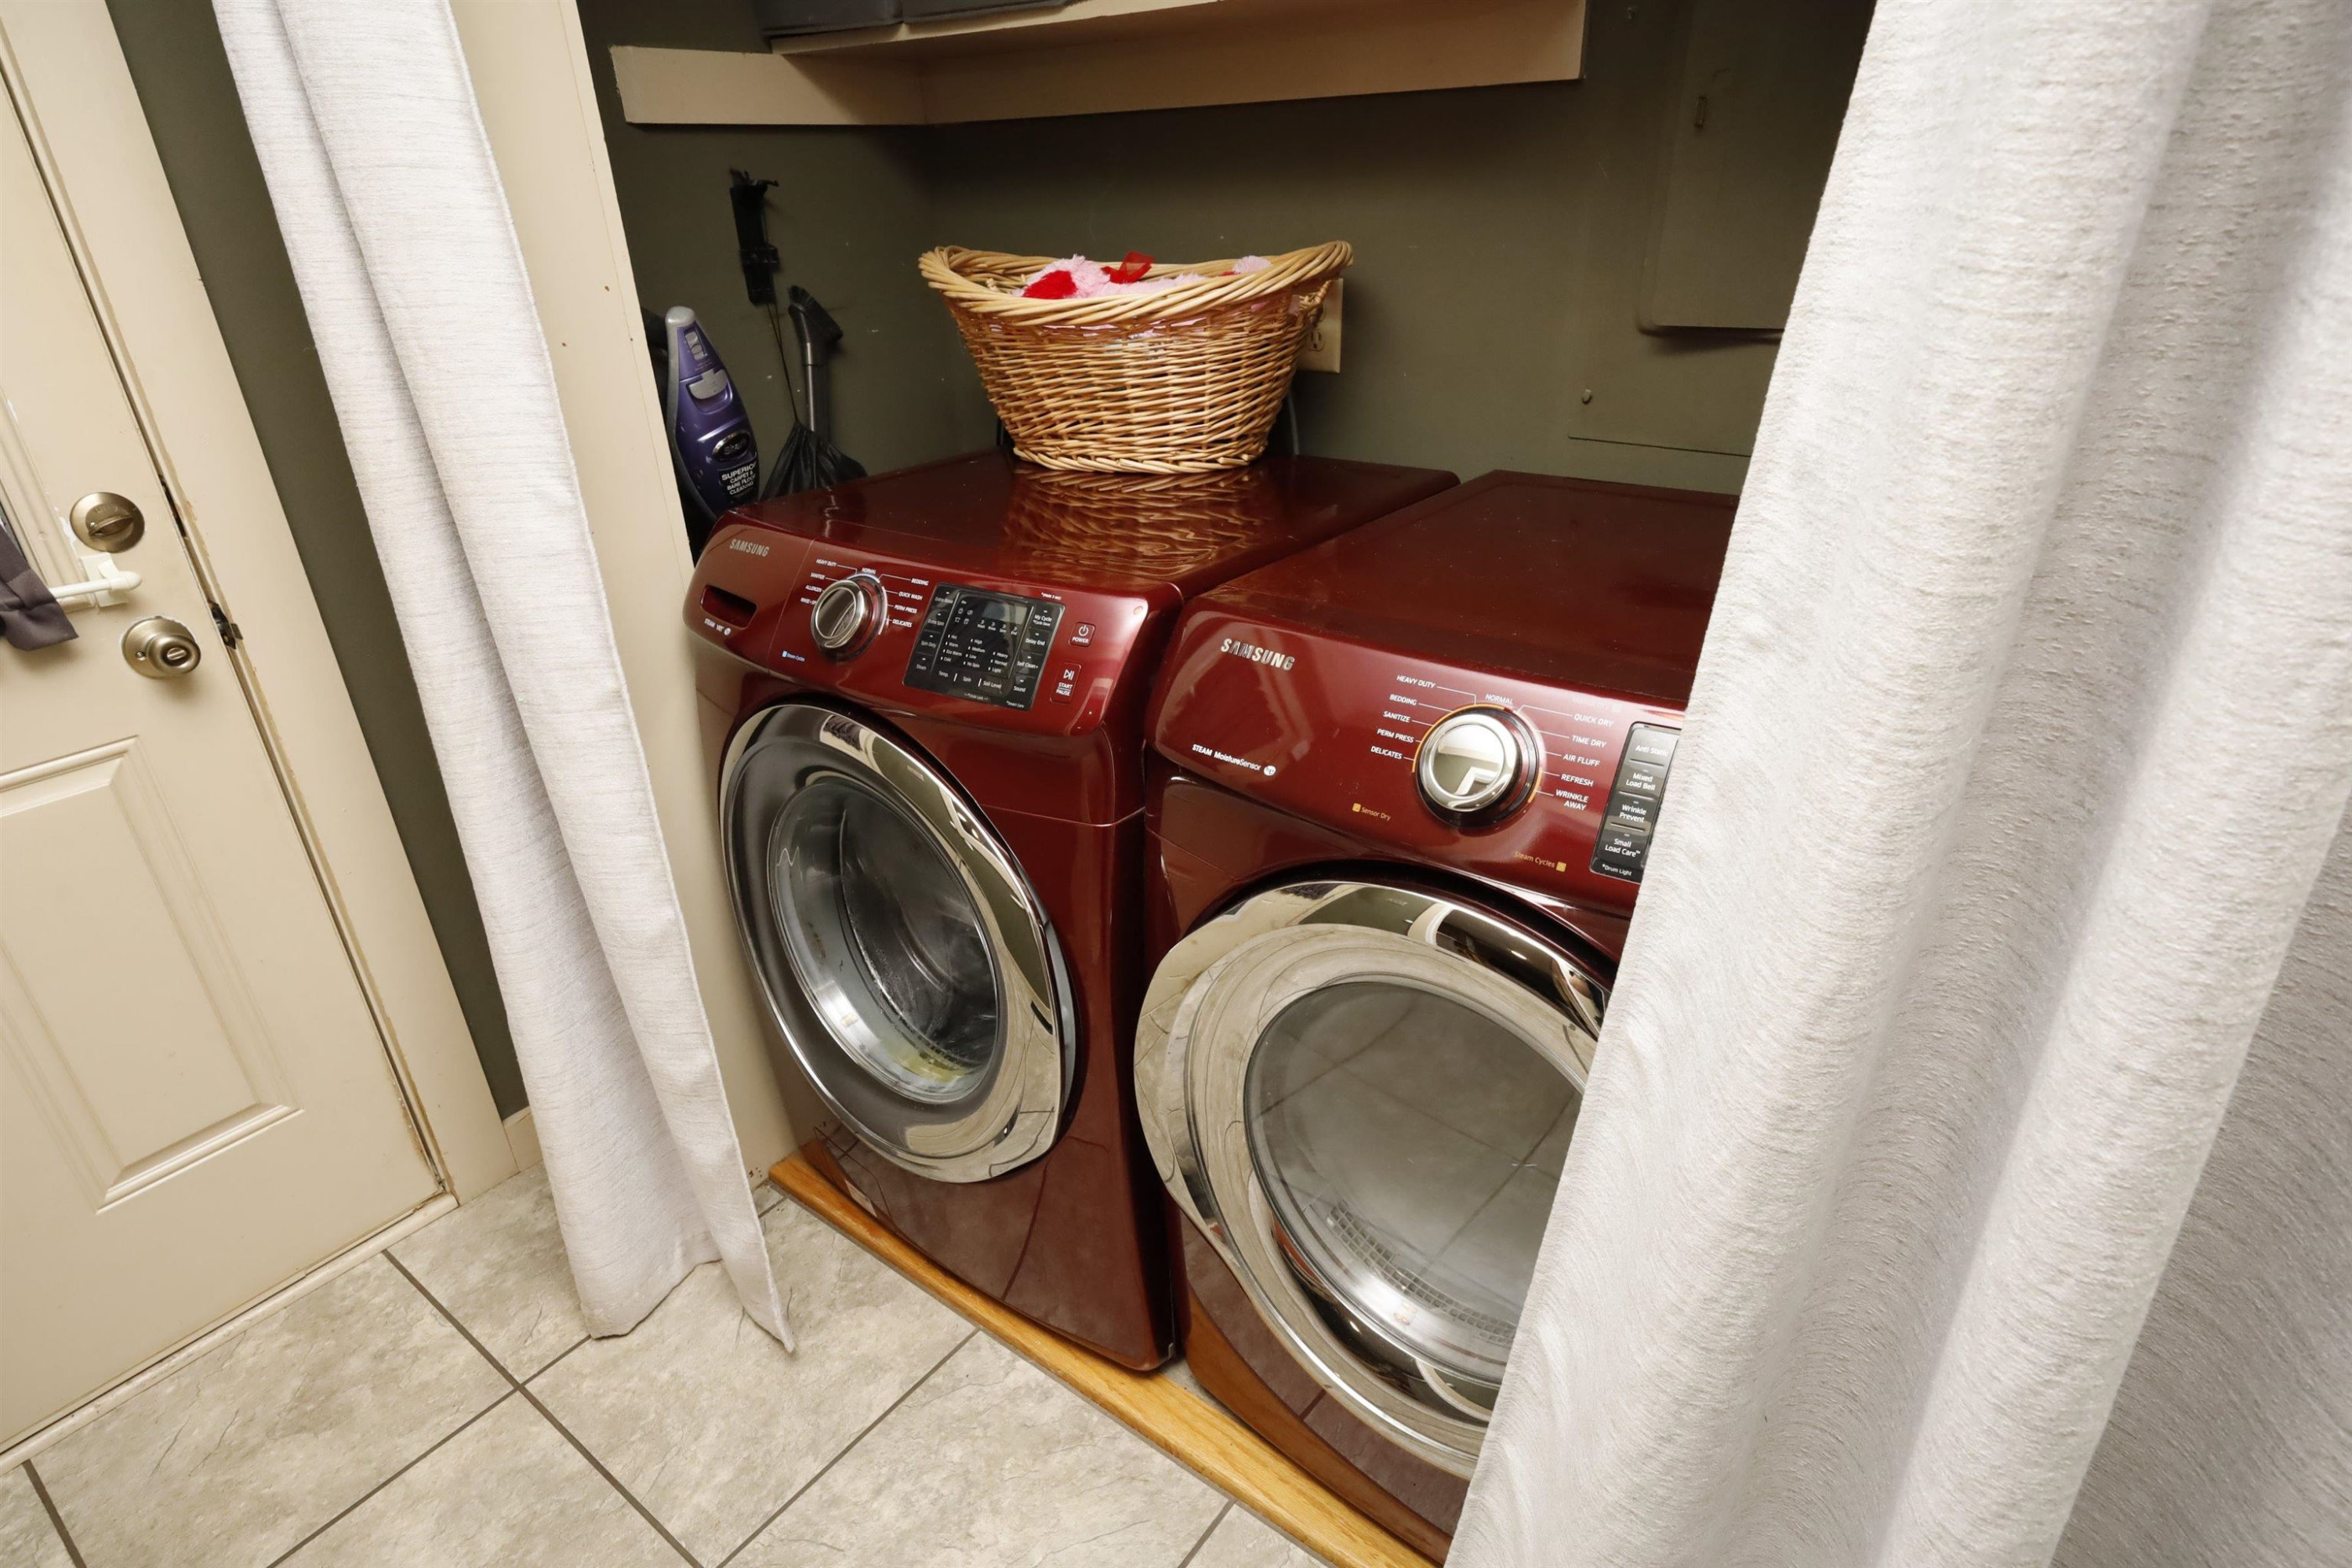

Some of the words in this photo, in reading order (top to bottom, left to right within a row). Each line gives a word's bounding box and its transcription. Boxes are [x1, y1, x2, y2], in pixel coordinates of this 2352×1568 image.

[729, 539, 770, 557] SAMSUNG
[911, 578, 929, 586] BEDDING
[892, 619, 913, 627] DELICATES
[1221, 638, 1295, 671] SAMSUNG
[1396, 674, 1417, 686] HEAVY
[1417, 679, 1436, 688] DUTY
[1389, 694, 1417, 706] BEDDING
[1485, 694, 1513, 706] NORMAL
[1383, 710, 1410, 723] SANITIZE
[1574, 713, 1597, 724] QUICK
[1598, 718, 1614, 728] DRY
[1377, 728, 1396, 739] PERM
[1395, 732, 1414, 743] PRESS
[1572, 735, 1590, 745] TIME
[1590, 739, 1607, 749] DRY
[1192, 744, 1214, 757] STEAM
[1214, 750, 1261, 771] MoistureSensor
[1370, 746, 1403, 760] DELICATES
[1635, 745, 1650, 754] Anti
[1650, 746, 1669, 757] Static
[1563, 753, 1577, 763] AIR
[1577, 756, 1600, 767] FLUFF
[1561, 773, 1594, 787] REFRESH
[1632, 772, 1653, 782] Mixed
[1625, 779, 1642, 789] Load
[1642, 782, 1655, 791] Bell
[1555, 789, 1589, 803] WRINKLE
[1564, 800, 1587, 811] AWAY
[1621, 804, 1647, 815] Wrinkle
[1361, 807, 1380, 817] Sensor
[1380, 811, 1392, 822] Dry
[1619, 812, 1645, 823] Prevent
[1605, 844, 1621, 855] Load
[1613, 838, 1632, 848] Small
[1514, 851, 1534, 862] Steam
[1534, 857, 1555, 868] Cycles
[1618, 867, 1632, 877] Light
